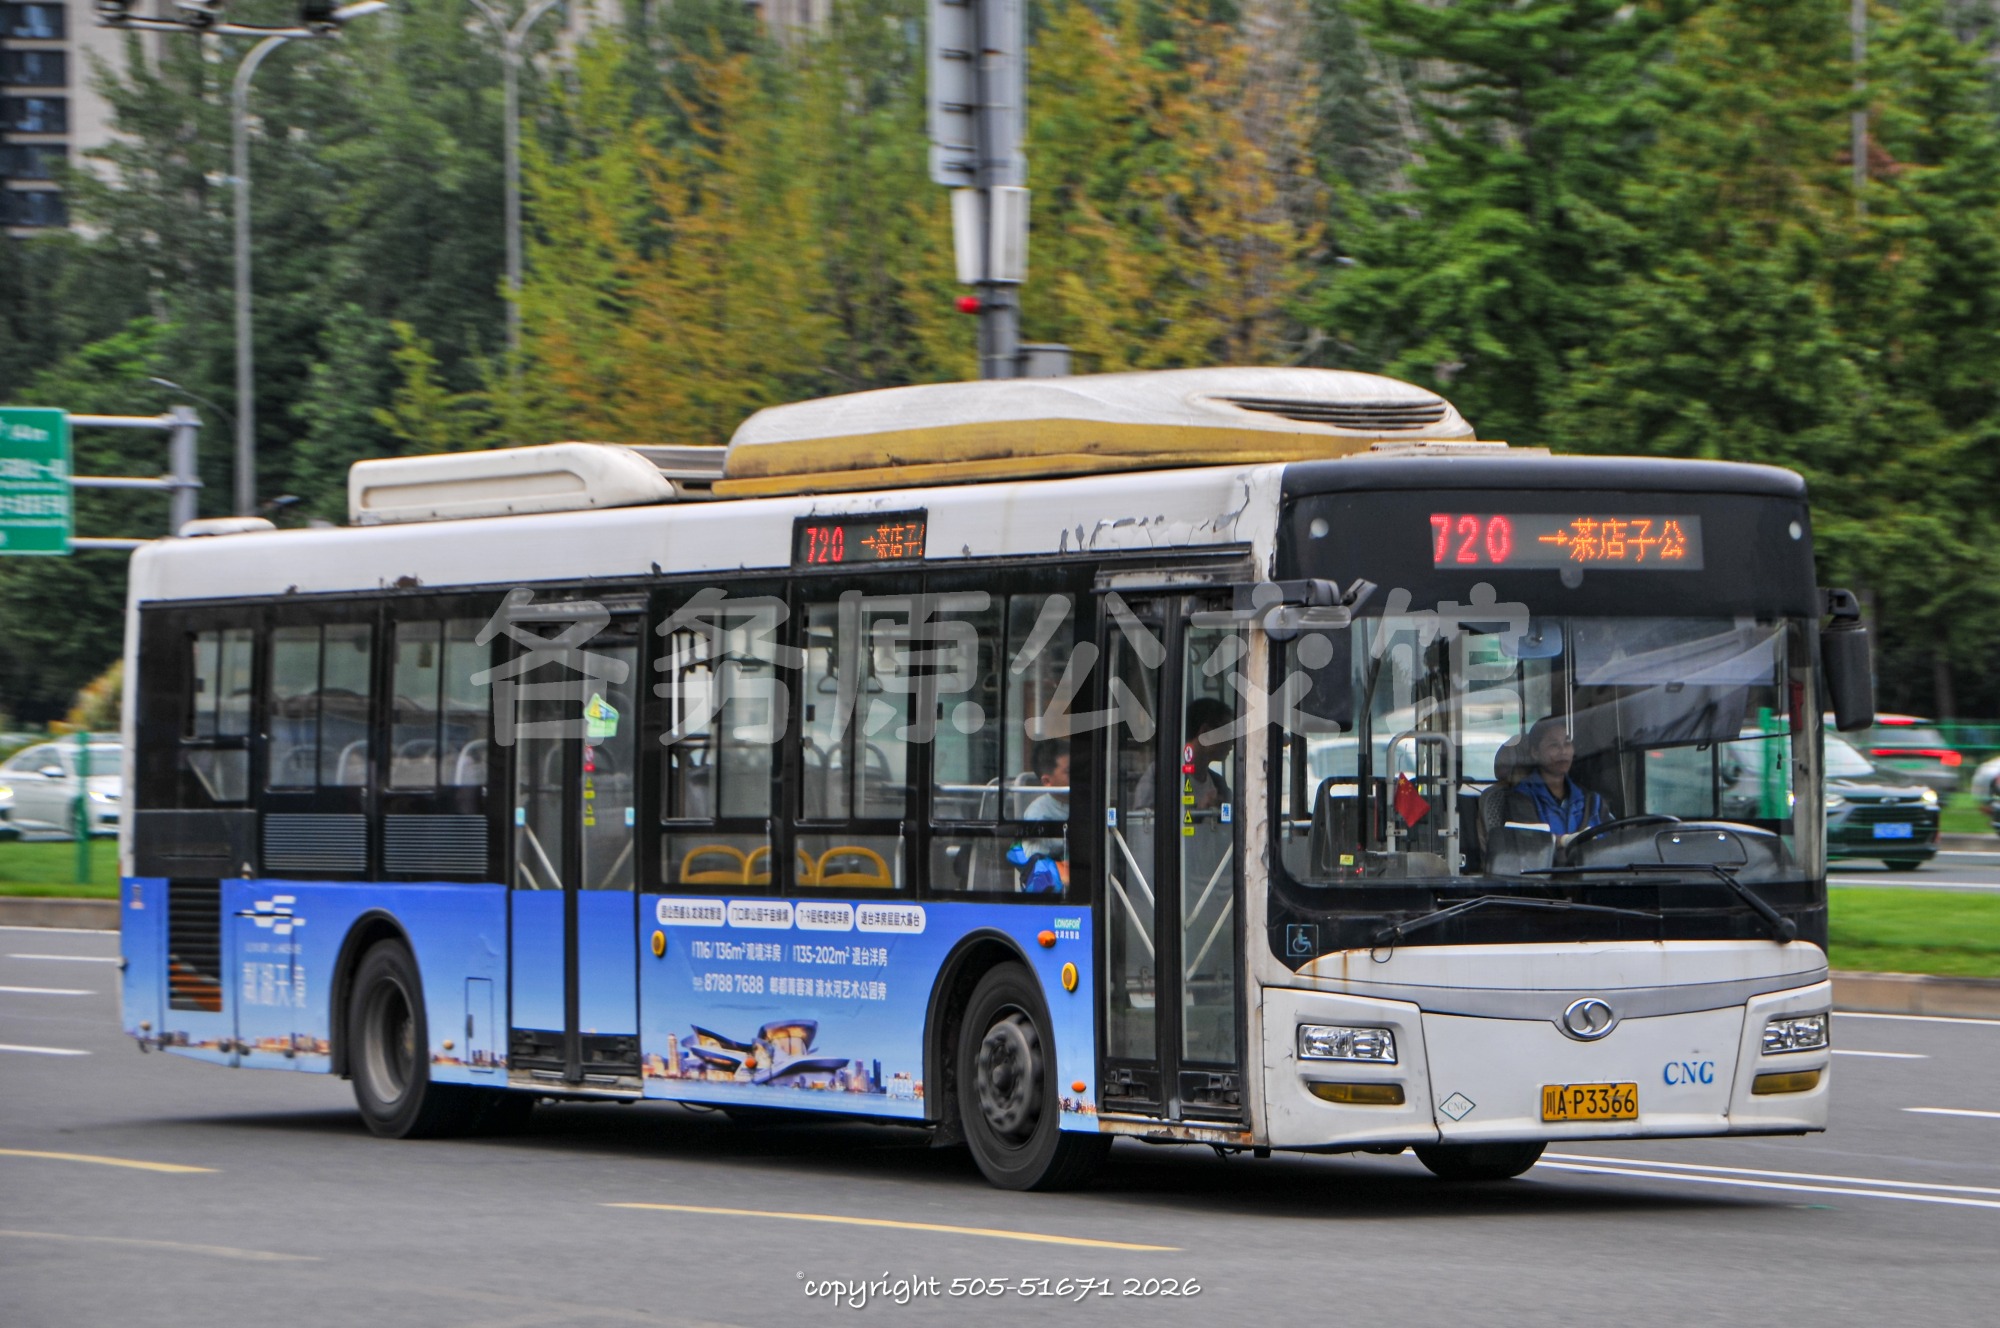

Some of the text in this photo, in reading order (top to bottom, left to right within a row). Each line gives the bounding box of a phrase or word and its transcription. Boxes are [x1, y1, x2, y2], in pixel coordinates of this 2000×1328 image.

[807, 526, 845, 563] 720
[1430, 514, 1686, 563] 720 茶店子公
[704, 973, 733, 993] 8788
[734, 974, 764, 994] 7688
[1663, 1061, 1714, 1085] CNG
[1447, 1101, 1467, 1111] CNG
